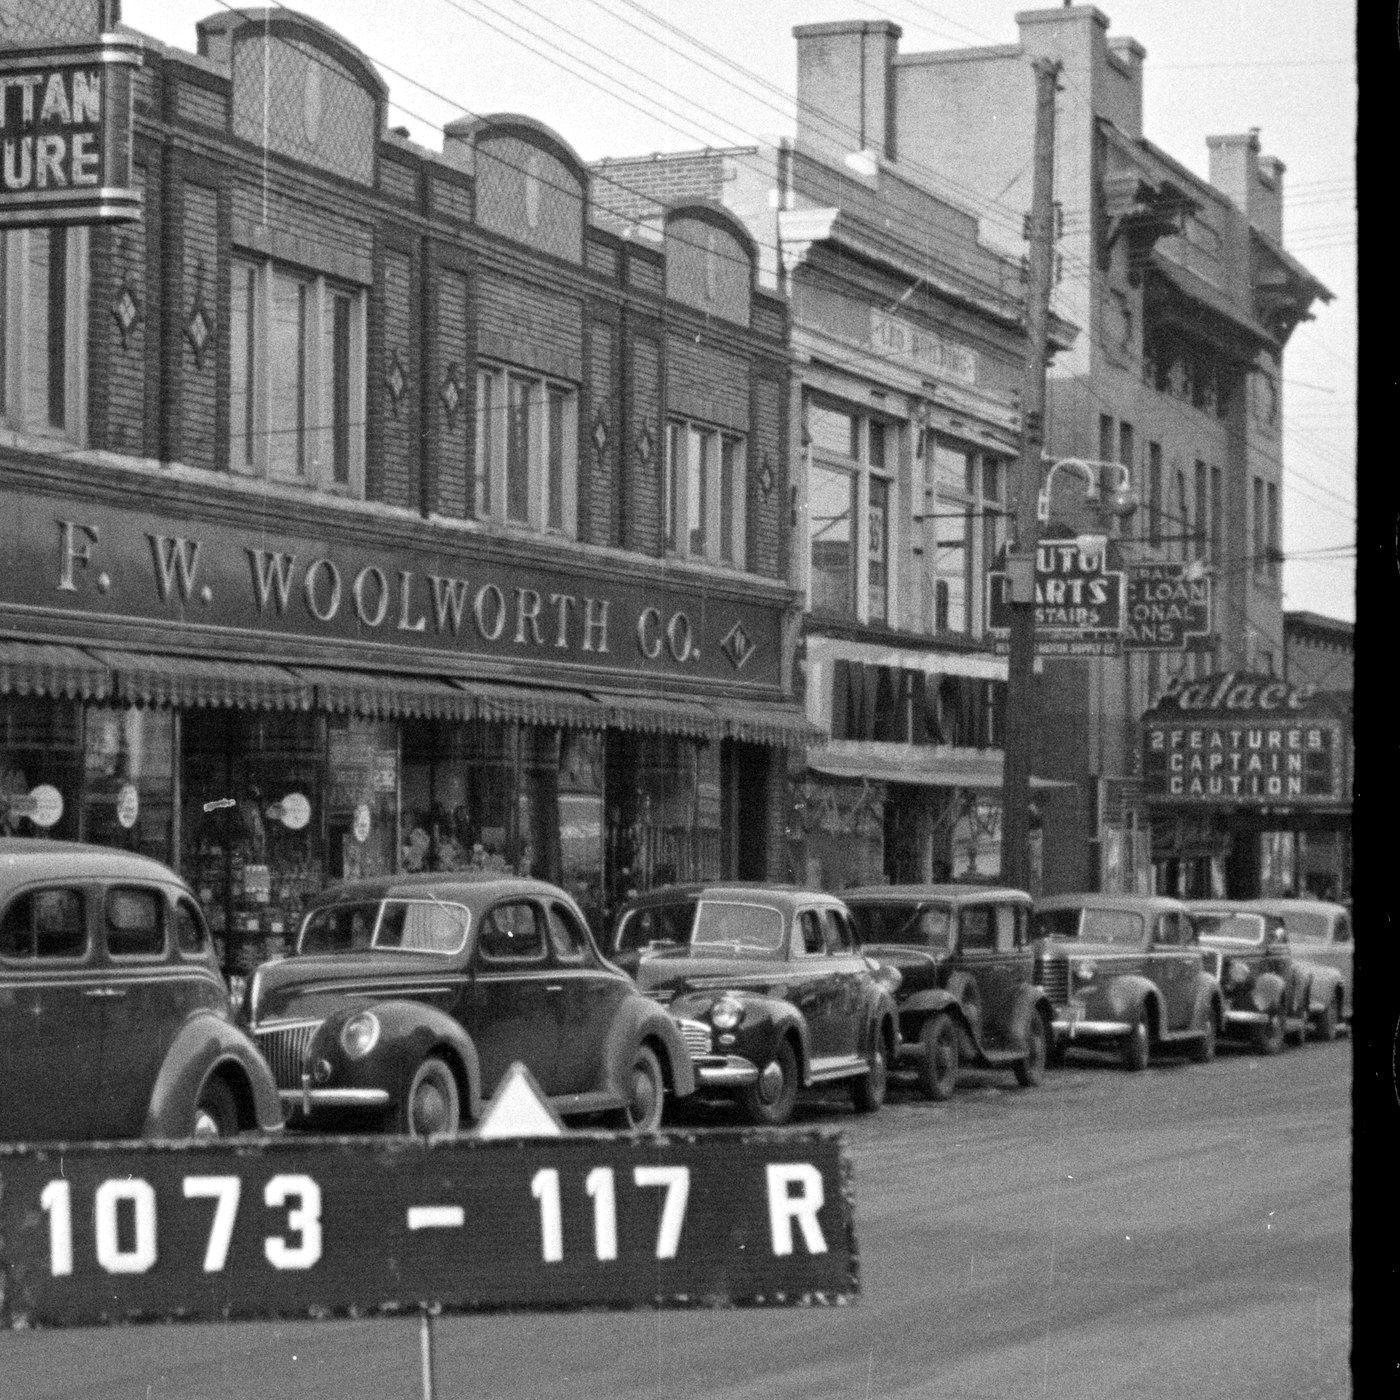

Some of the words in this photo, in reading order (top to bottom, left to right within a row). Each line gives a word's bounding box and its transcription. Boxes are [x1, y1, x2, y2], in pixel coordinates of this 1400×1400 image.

[1036, 547, 1100, 573] UTO
[55, 520, 111, 592] F.
[144, 533, 213, 602] W.
[243, 548, 611, 654] WOOLWORTH
[637, 607, 701, 662] CO.
[1035, 579, 1108, 604] ARTS
[1144, 583, 1205, 601] LOAN
[1170, 753, 1301, 772] CAPTAIN
[1170, 776, 1301, 796] CAUTION
[39, 1174, 324, 1277] 1073
[530, 1165, 692, 1265] 117
[764, 1162, 830, 1257] R
